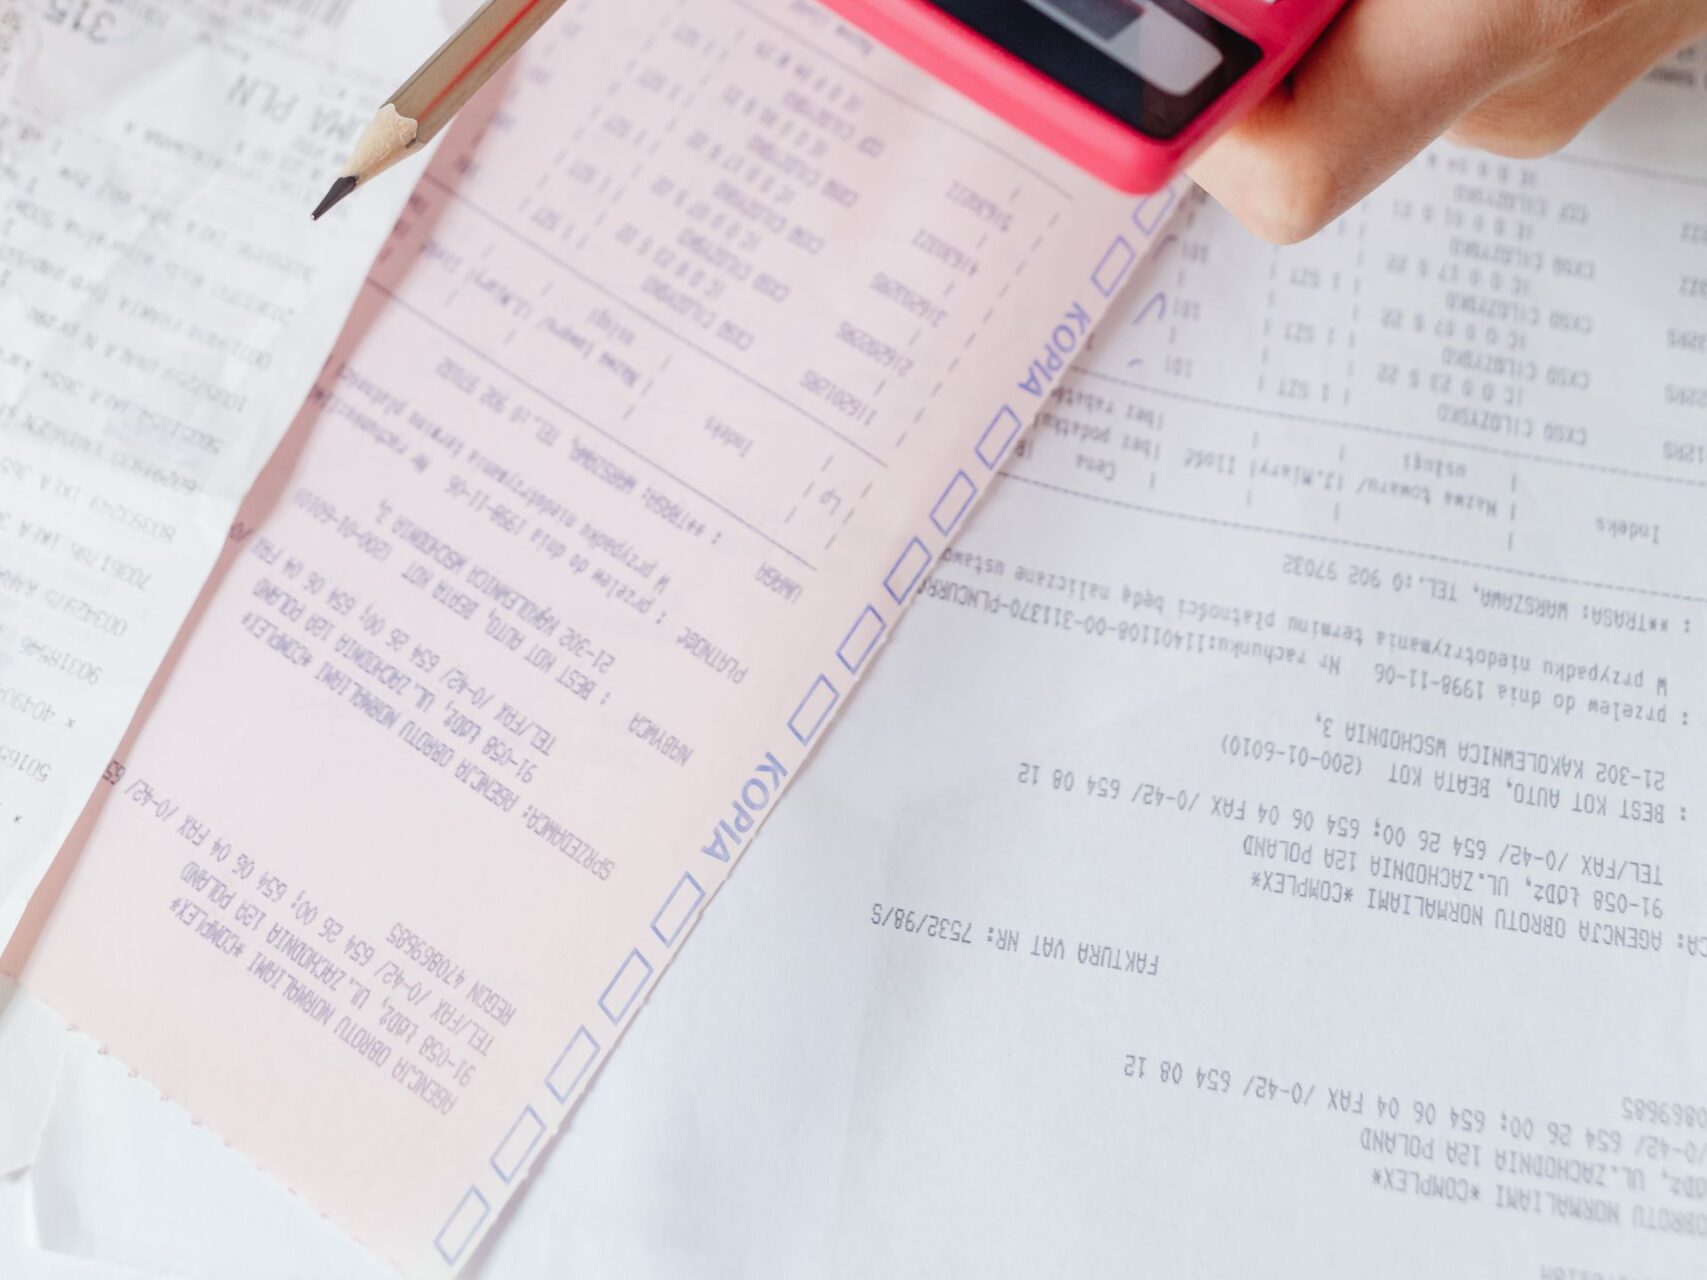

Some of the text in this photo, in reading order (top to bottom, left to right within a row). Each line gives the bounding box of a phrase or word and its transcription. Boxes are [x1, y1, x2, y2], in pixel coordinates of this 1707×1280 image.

[225, 74, 299, 123] PLN
[1017, 301, 1091, 399] KOPIA
[1075, 454, 1116, 481] Cena
[1596, 517, 1660, 544] Indeks
[401, 561, 434, 588] KOT
[568, 552, 590, 574] do
[1282, 554, 1337, 580] 97032
[1348, 565, 1381, 588] 902
[591, 568, 656, 614] przelew
[755, 561, 804, 604] UWAGA
[1015, 566, 1109, 601] naliczane
[253, 578, 306, 622] POLAND
[326, 587, 357, 616] 654
[432, 579, 479, 620] BEATA
[1473, 583, 1568, 620] WARSZAWA,
[1288, 615, 1363, 643] terminu
[409, 643, 440, 673] 654
[523, 642, 557, 674] KOT
[558, 626, 615, 674] 21-302
[1376, 629, 1531, 671] niedotrzymania
[554, 667, 596, 701] BEST
[1319, 654, 1666, 723] przelew do dnia 1998-11-06 Nr
[1542, 657, 1644, 688] przypadku
[1656, 677, 1668, 695] W
[493, 702, 557, 756] TEL/FAX
[628, 712, 693, 767] NABYWCA
[481, 735, 538, 784] 91-058
[1316, 712, 1665, 791] 21-302 KĄKOLEWNICA WSCHODNIA 3,
[314, 661, 615, 881] SPRZEDAWCA: AGENCJA OBROTU NORMALIAMI
[1221, 734, 1664, 824] BEST KOT AUTO, BEATA KOT (200-01-6010)
[124, 779, 180, 822] /0-42/
[698, 748, 789, 864] KOPIA
[176, 815, 210, 847] FAX
[1017, 762, 1663, 886] TEL/FAX /0-42/ 654 26 00; 654 06 04 FAX /0-42/ 654 08 12
[211, 836, 232, 862] 04
[1243, 834, 1312, 865] POLAND
[1324, 847, 1356, 872] 12A
[235, 853, 256, 880] 06
[1369, 855, 1508, 896] UL.ZACHODNIA
[179, 859, 235, 910] POLAND
[256, 871, 288, 902] 654
[234, 900, 267, 931] 12A
[1367, 887, 1483, 927] NORMALIAMI
[1592, 890, 1662, 918] 91-058
[322, 916, 344, 944] 26
[870, 903, 1159, 975] FAKTURA VAT NR: 7532/98/S
[1494, 908, 1566, 939] OBROTU
[1578, 920, 1662, 951] AGENCJA
[342, 934, 375, 966] 654
[246, 951, 336, 1025] NORMALIAMI
[375, 960, 431, 1007] /0-42/
[386, 922, 517, 1026] REGON 470869685
[333, 1016, 392, 1068] OBROTU
[430, 998, 495, 1057] TEL/FAX
[419, 1034, 477, 1087] 91-058
[1123, 1054, 1146, 1078] 12
[1159, 1060, 1182, 1084] 08
[392, 1056, 457, 1115] AGENCJA
[1196, 1066, 1231, 1093] 654
[1243, 1074, 1316, 1107] /0-42/
[1327, 1087, 1363, 1113] FAX
[1377, 1094, 1399, 1118] 04
[1413, 1101, 1436, 1125] 06
[1449, 1107, 1486, 1133] 654
[1546, 1121, 1572, 1145] 26
[1585, 1127, 1622, 1153] 654
[1359, 1127, 1645, 1191] UL.ZACHODNIA 12A POLAND
[1494, 1183, 1620, 1226] NORMALIAMI
